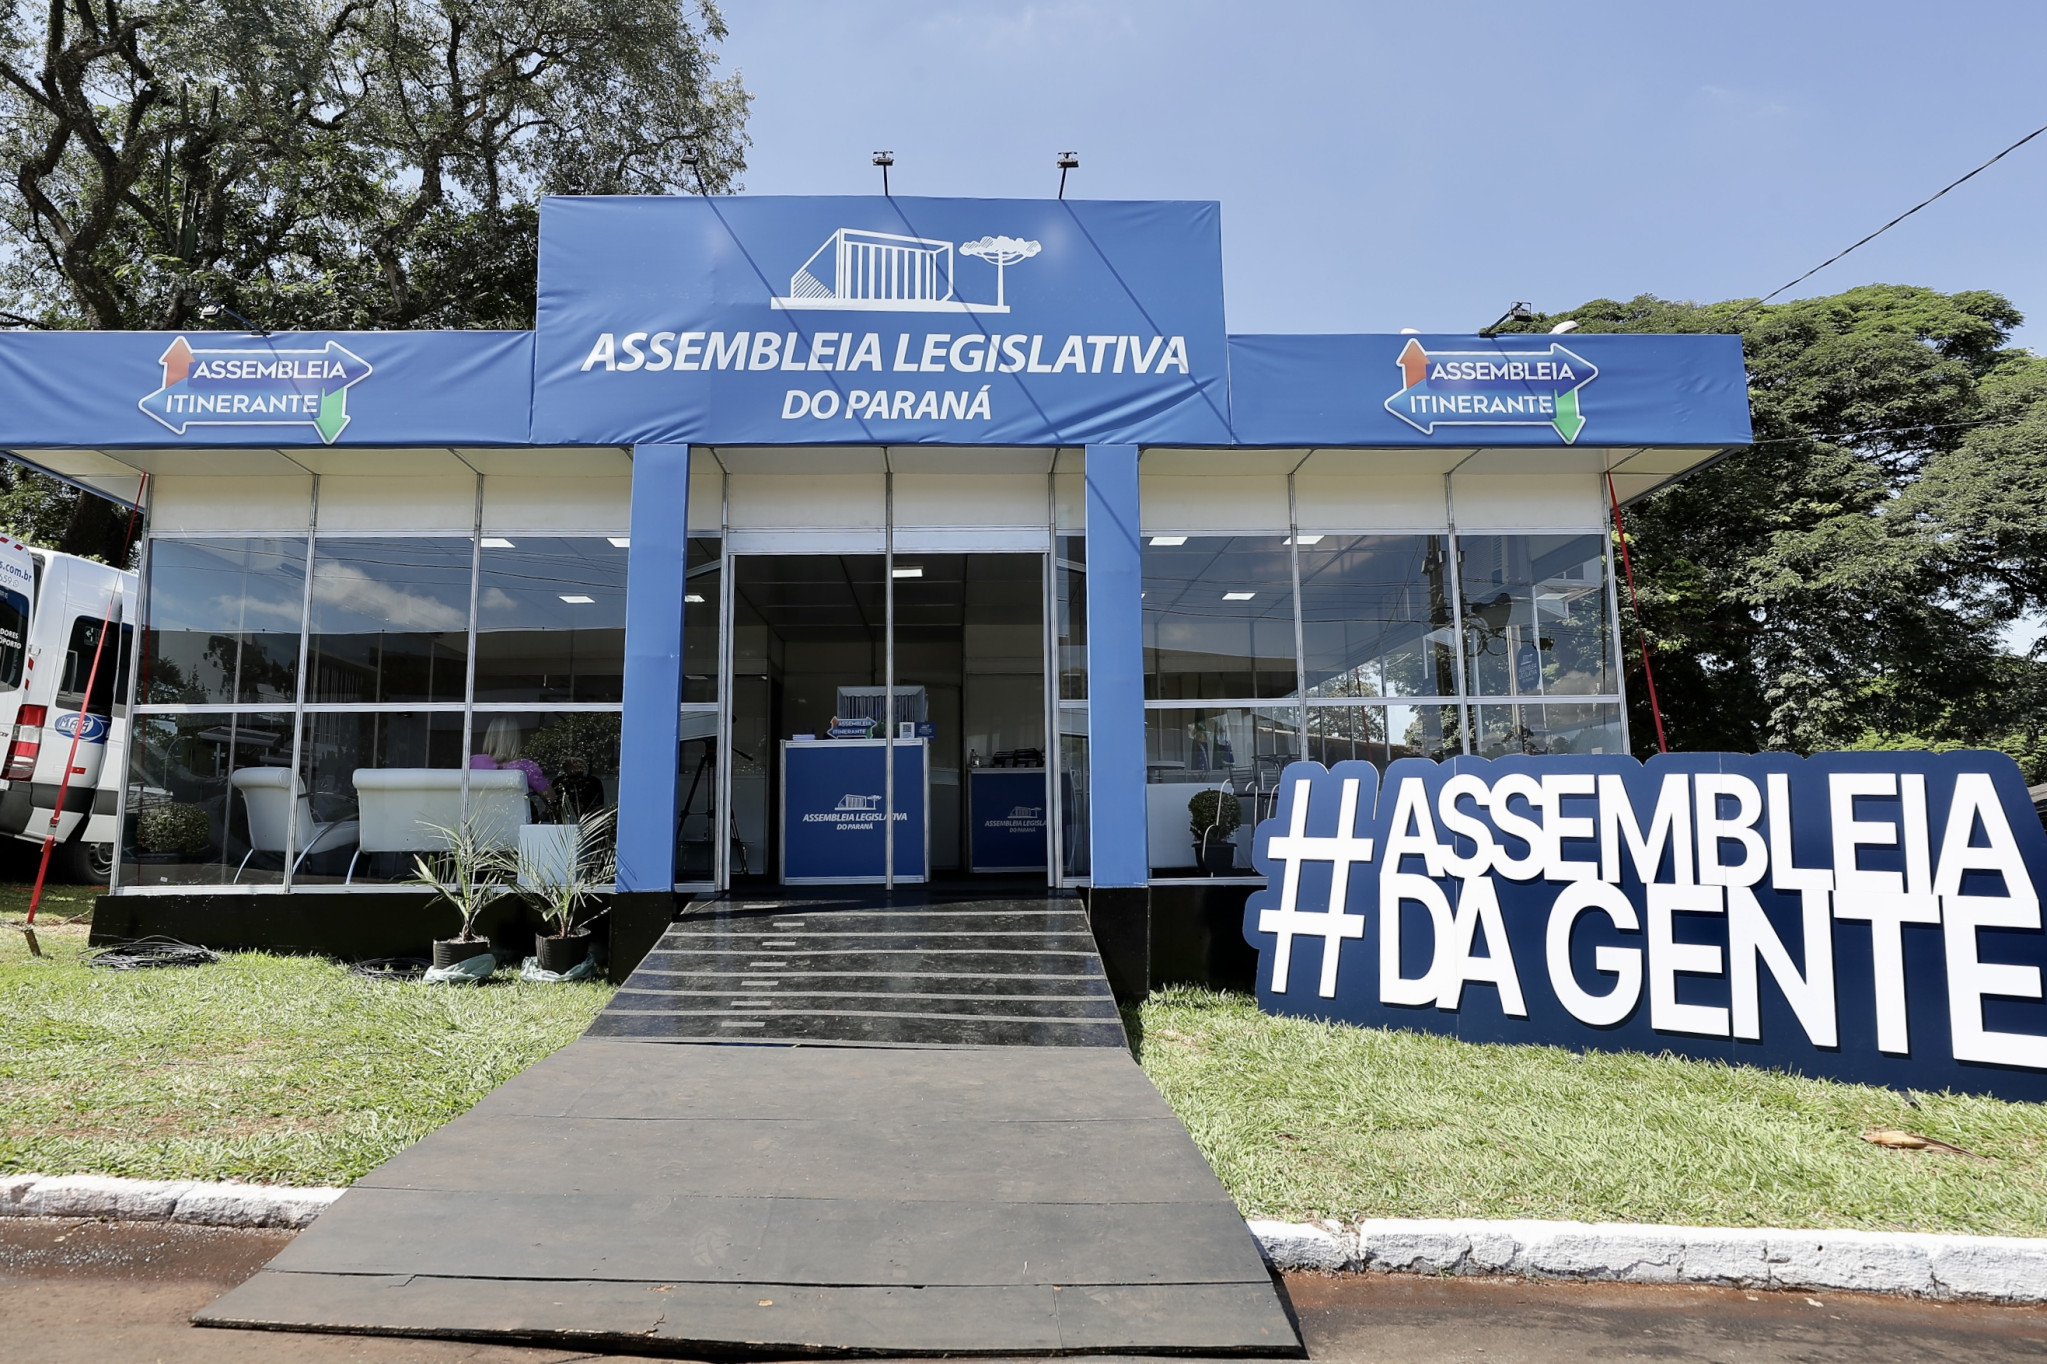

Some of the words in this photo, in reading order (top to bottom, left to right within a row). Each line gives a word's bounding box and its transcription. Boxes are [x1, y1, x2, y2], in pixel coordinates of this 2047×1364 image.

[581, 331, 883, 373] ASSEMBLEIA
[892, 334, 1190, 375] LEGISLATIVA
[192, 360, 347, 379] ASSEMBLEIA
[1430, 361, 1576, 381] ASSEMBLEIA
[165, 394, 318, 414] ITINERANTE
[781, 390, 839, 420] DO
[845, 385, 992, 421] PARANÁ
[1410, 396, 1553, 414] ITINERANTE
[803, 813, 855, 822] ASSEMBLEIA
[836, 823, 847, 831] DO
[847, 822, 873, 830] PARANÁ
[1379, 872, 1527, 1017] DA
[1545, 880, 2047, 1068] GENTE
